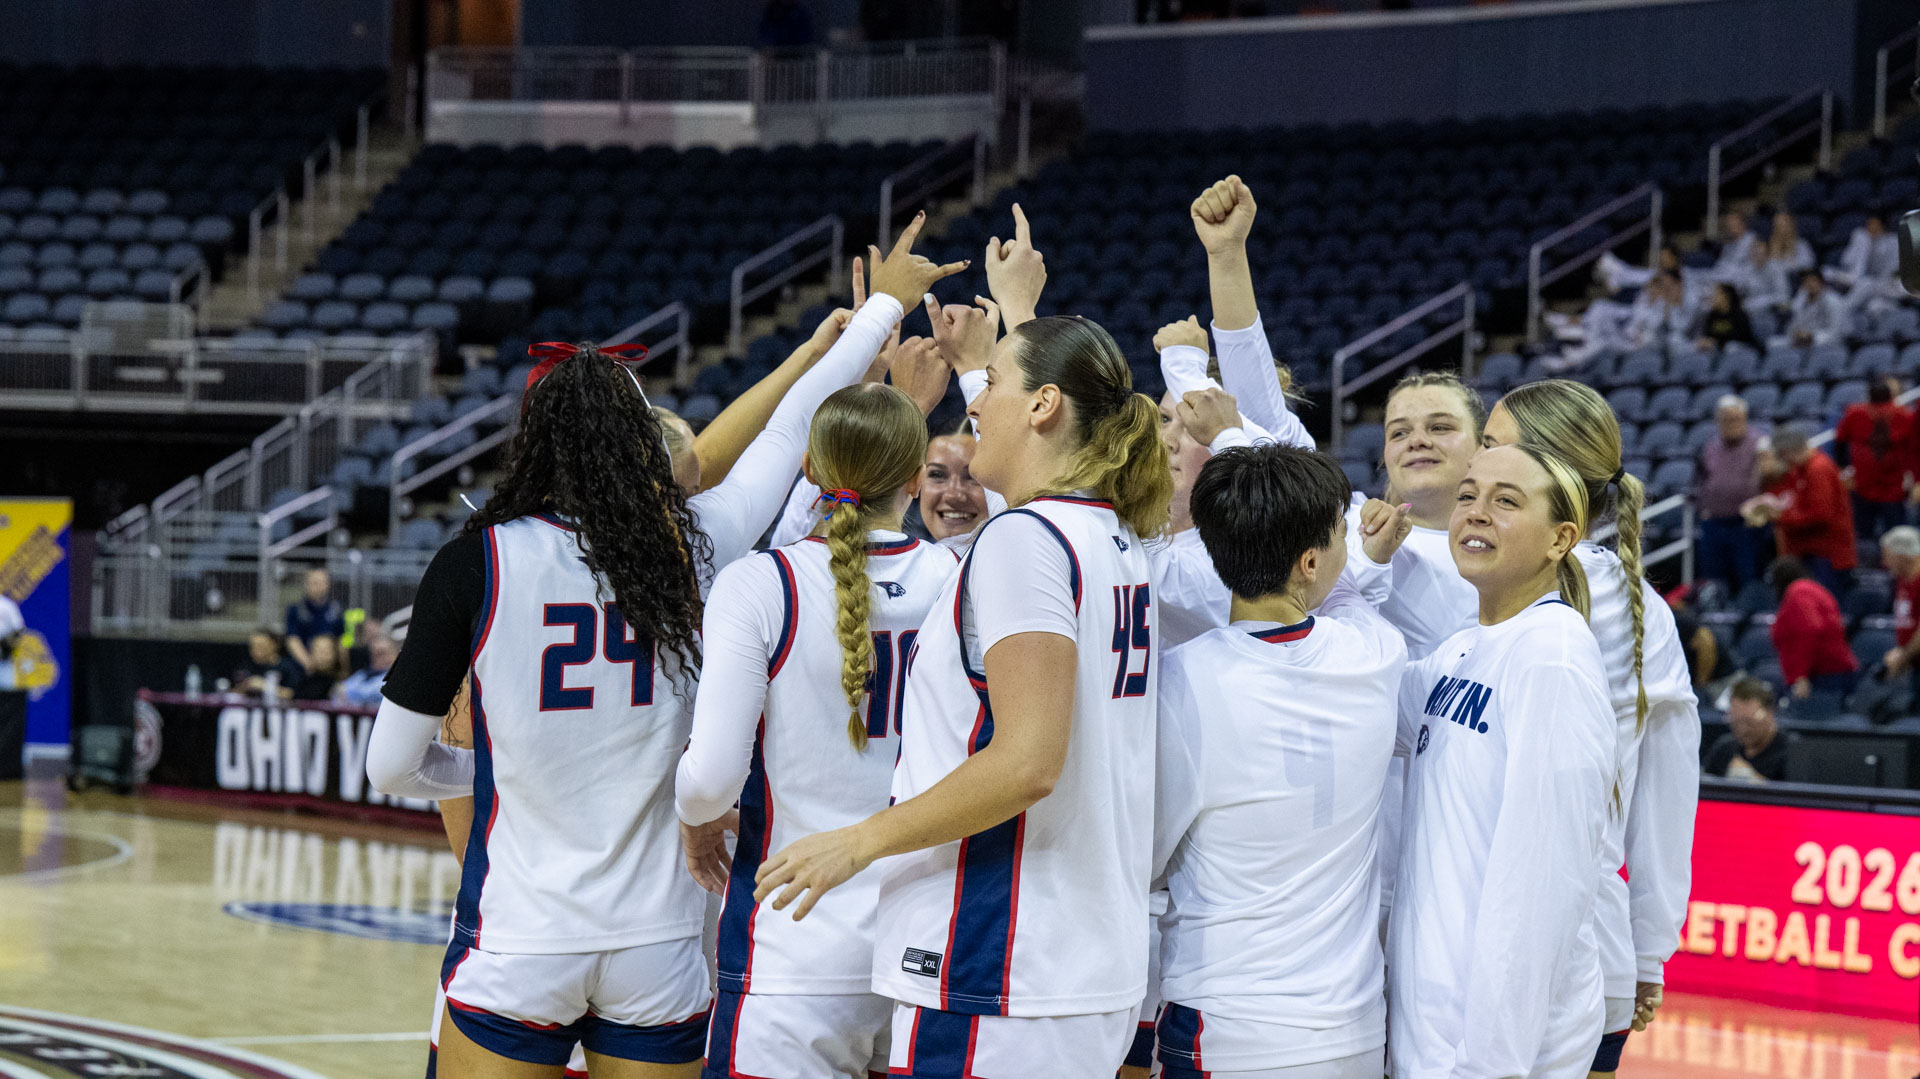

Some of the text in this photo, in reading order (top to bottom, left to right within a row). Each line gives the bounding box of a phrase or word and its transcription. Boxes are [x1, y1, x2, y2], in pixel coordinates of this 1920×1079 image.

[539, 602, 655, 712] 24
[1111, 583, 1152, 699] 45
[1451, 681, 1493, 734] IN.
[216, 706, 330, 797] OHIO
[1791, 841, 1920, 915] 2026
[924, 960, 936, 969] XXL
[1677, 900, 1872, 974] ETBALL
